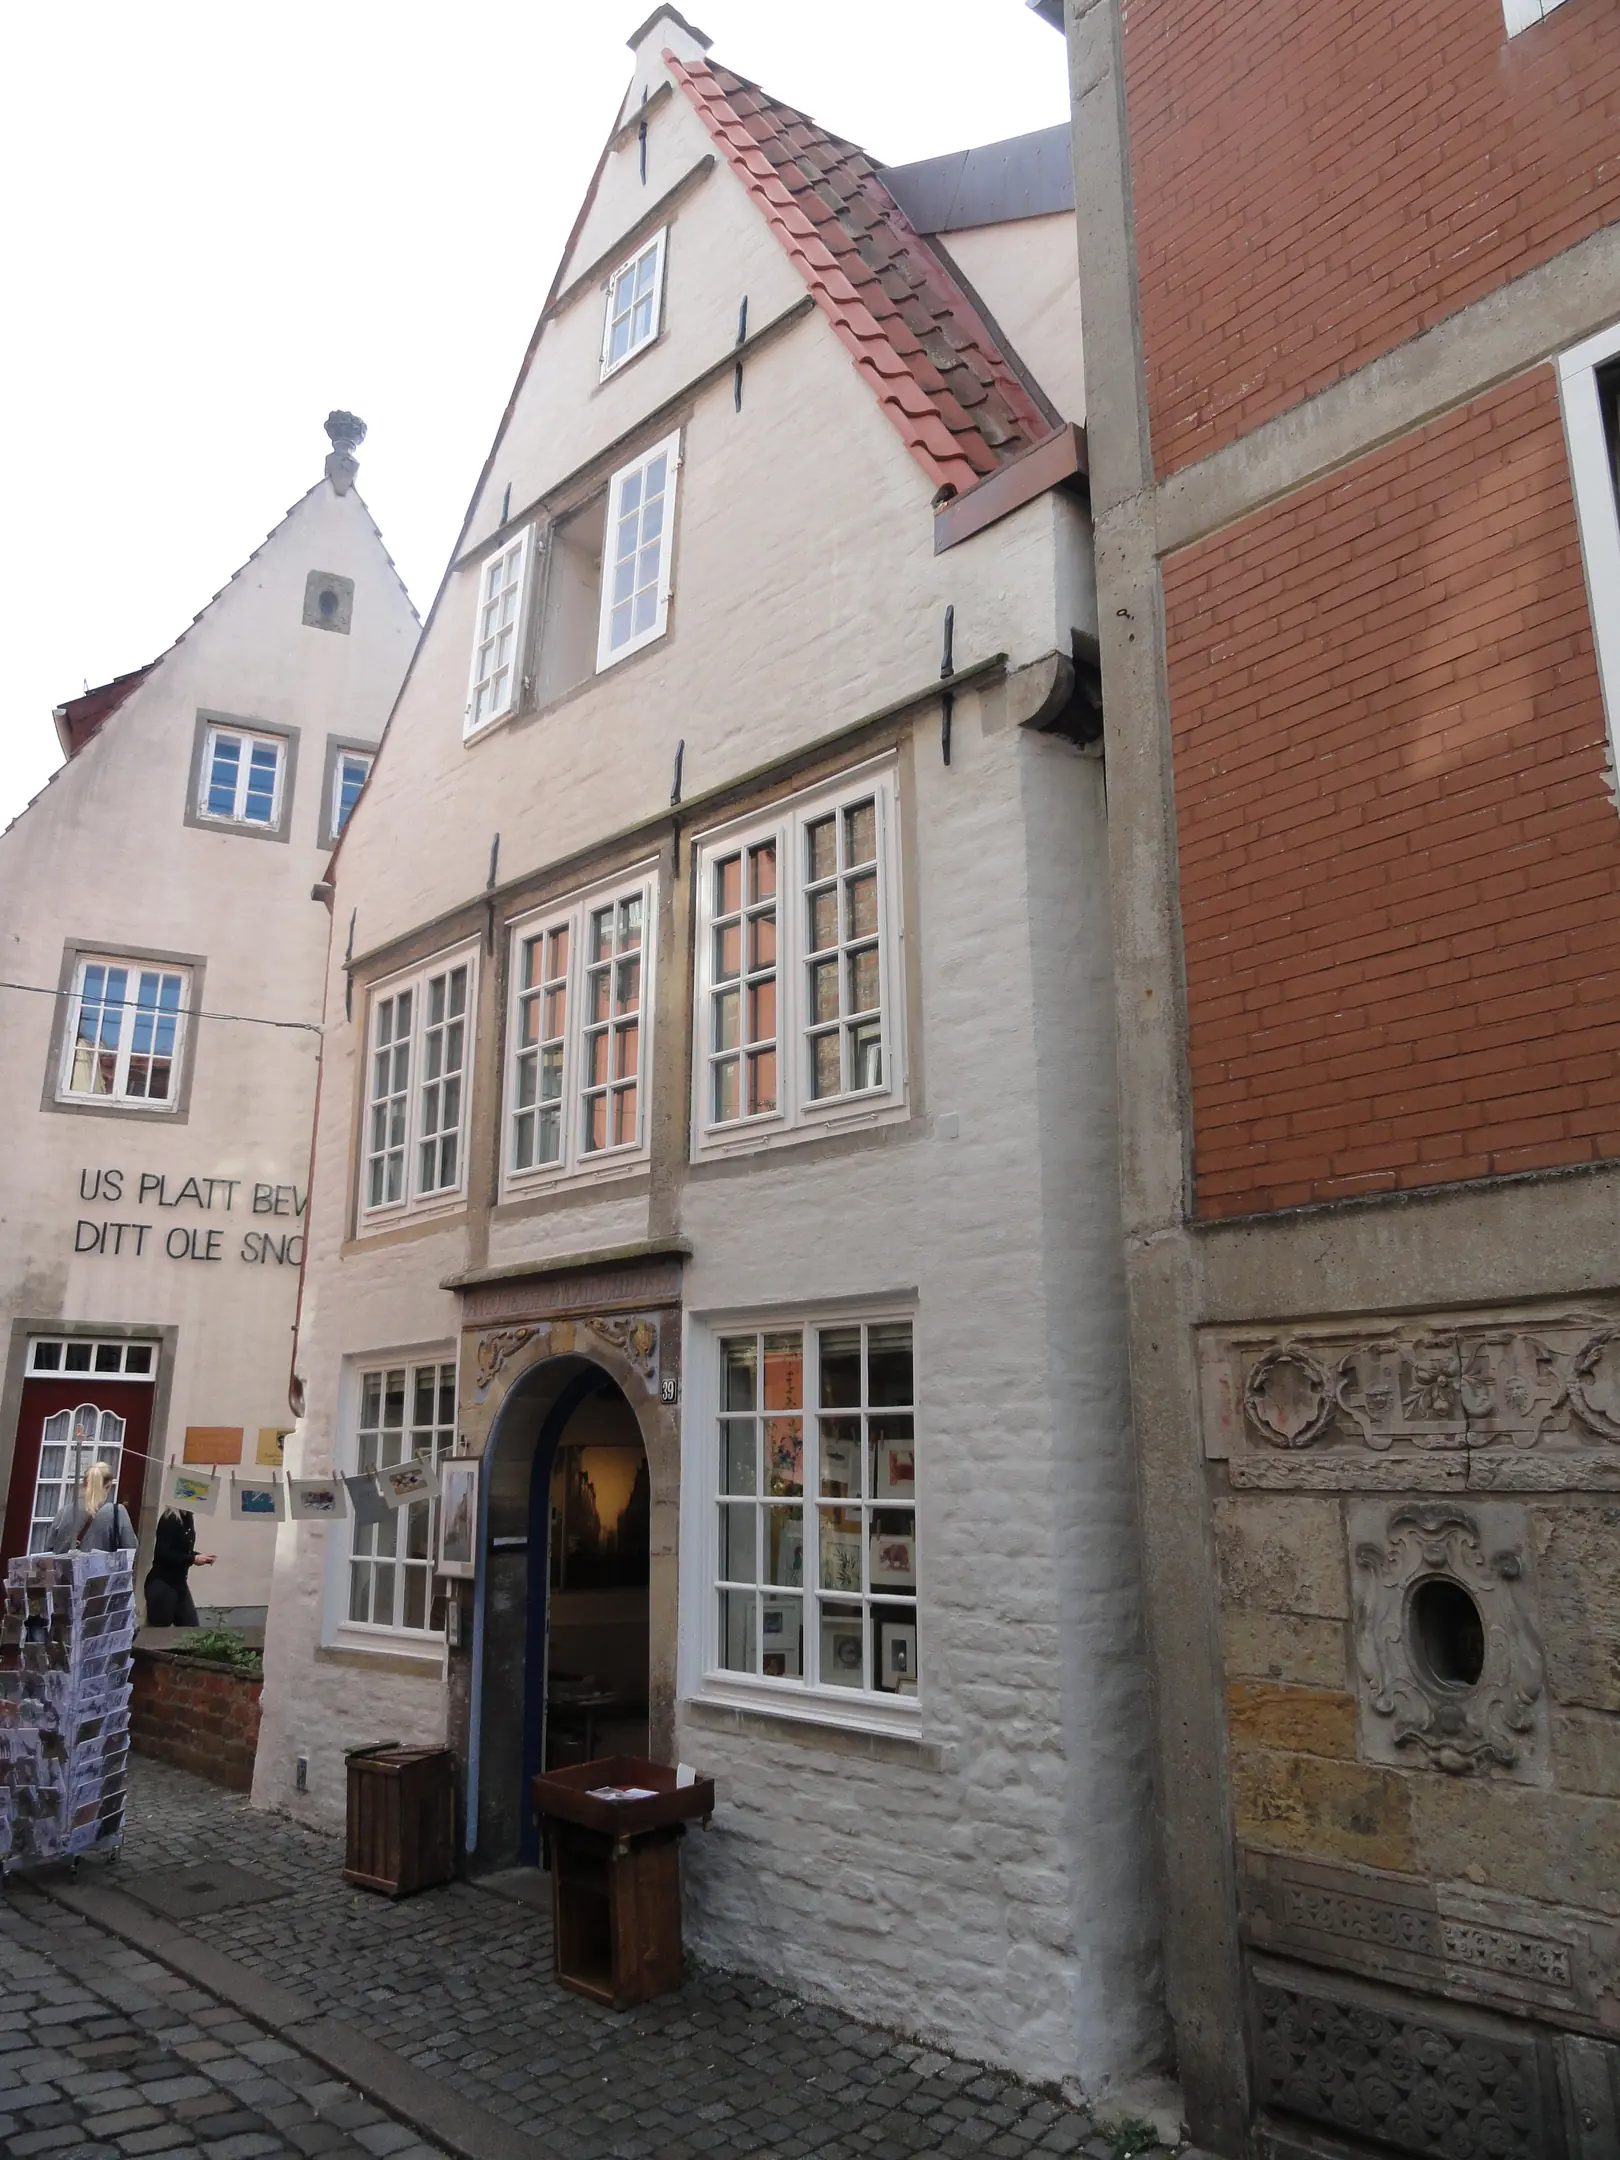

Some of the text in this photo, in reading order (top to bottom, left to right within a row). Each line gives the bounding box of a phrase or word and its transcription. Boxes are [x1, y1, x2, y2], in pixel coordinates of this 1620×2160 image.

[80, 1168, 124, 1202] US
[138, 1172, 241, 1211] PLATT
[74, 1219, 153, 1256] DITT
[166, 1227, 224, 1261] OLE
[662, 1381, 674, 1400] 39
